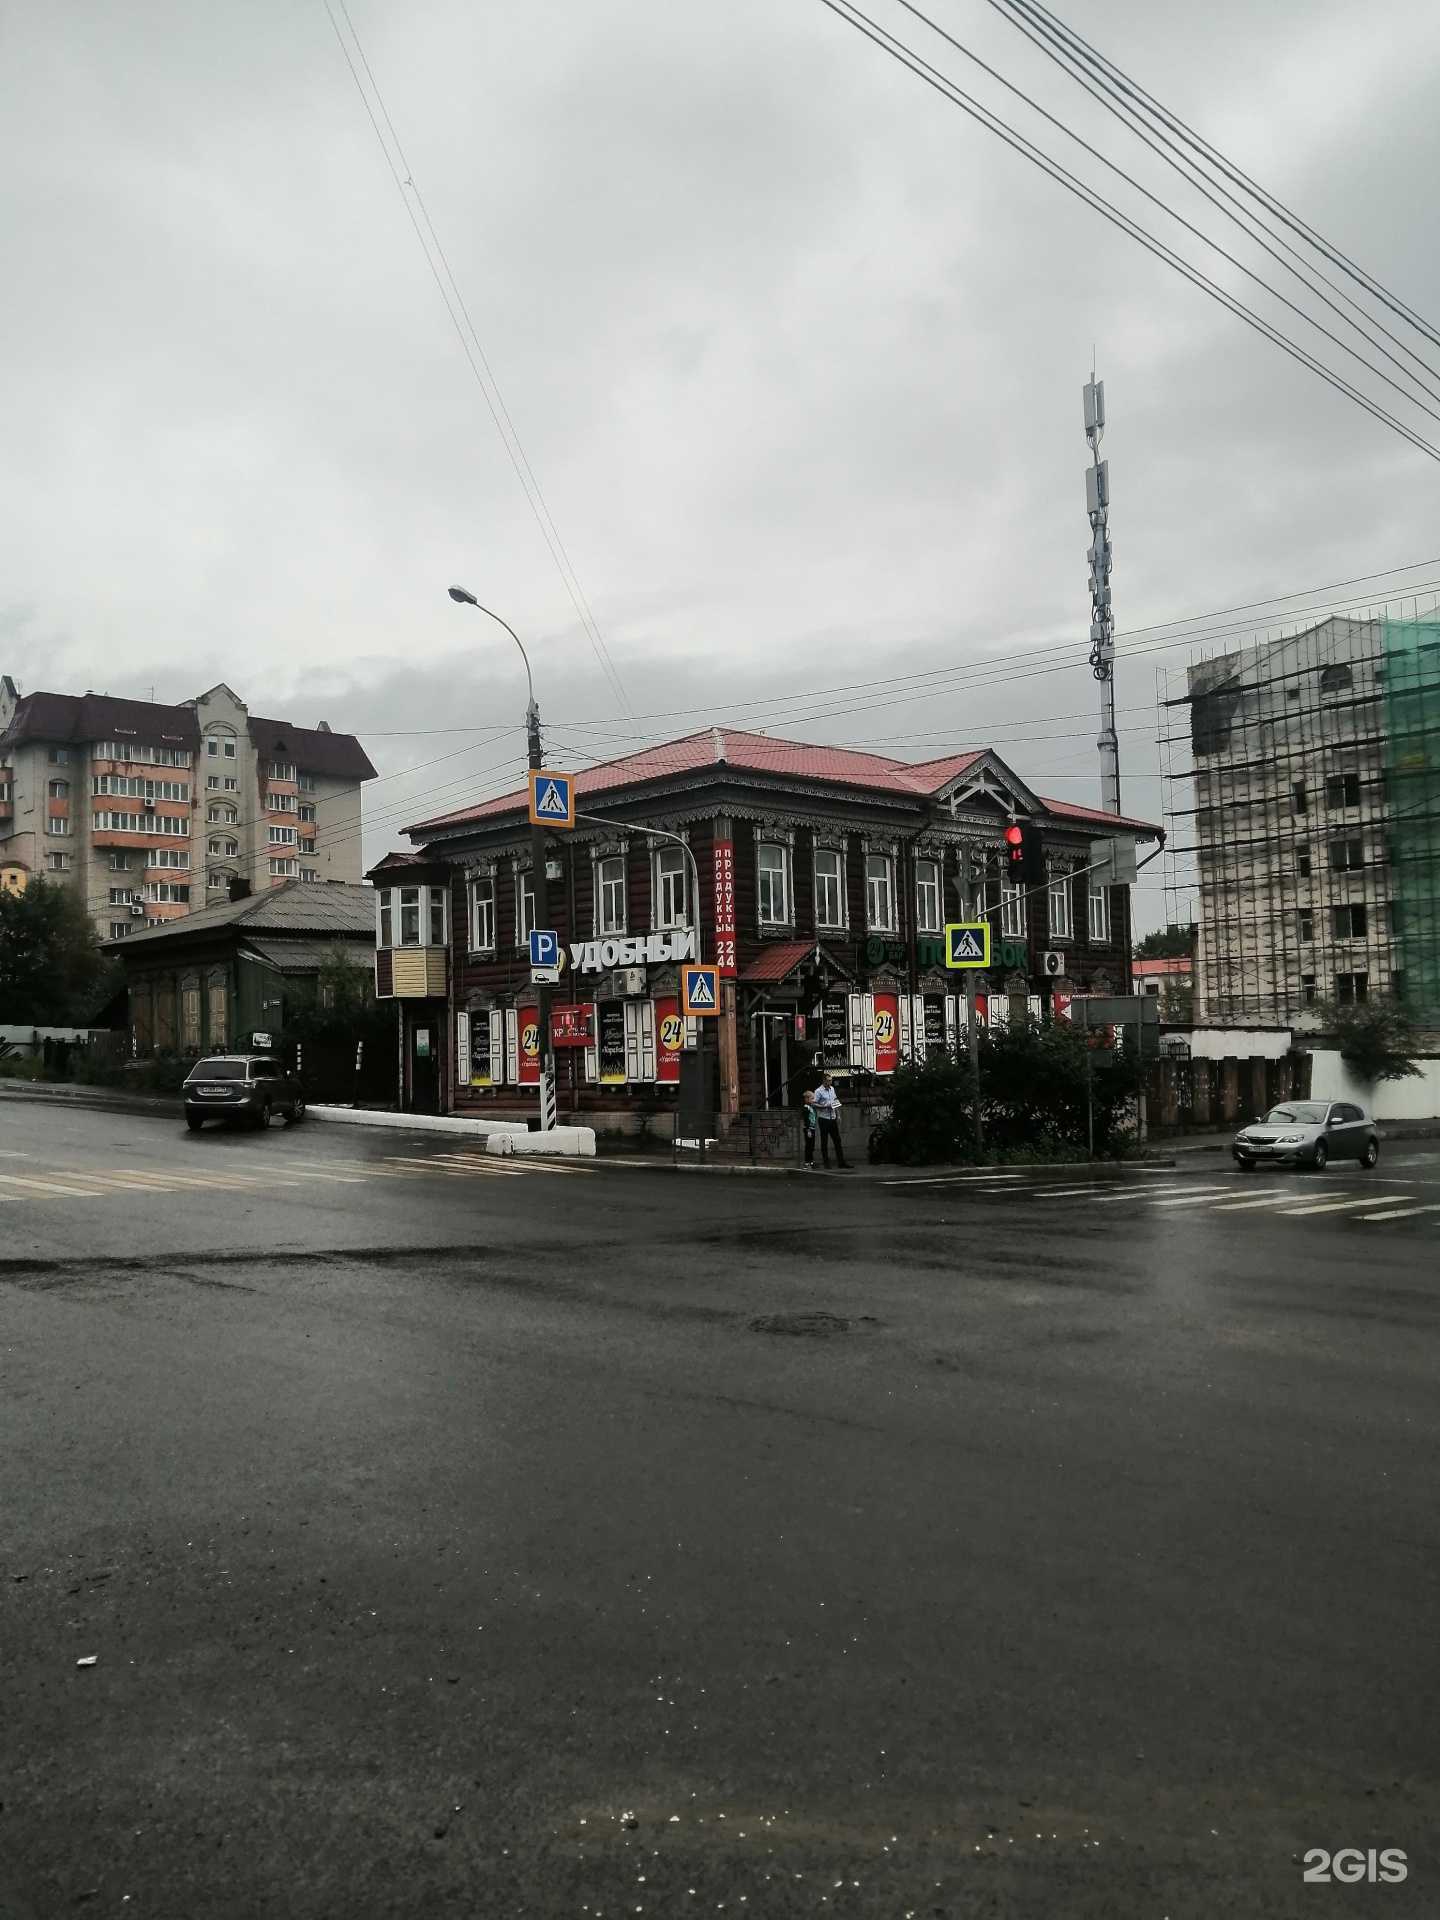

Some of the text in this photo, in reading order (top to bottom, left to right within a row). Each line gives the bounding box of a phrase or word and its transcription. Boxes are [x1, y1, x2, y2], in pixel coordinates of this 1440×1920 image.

[569, 927, 695, 974] УДОБНЫЙ
[663, 1021, 682, 1043] 24
[876, 1016, 892, 1036] 24
[524, 1029, 541, 1049] 24
